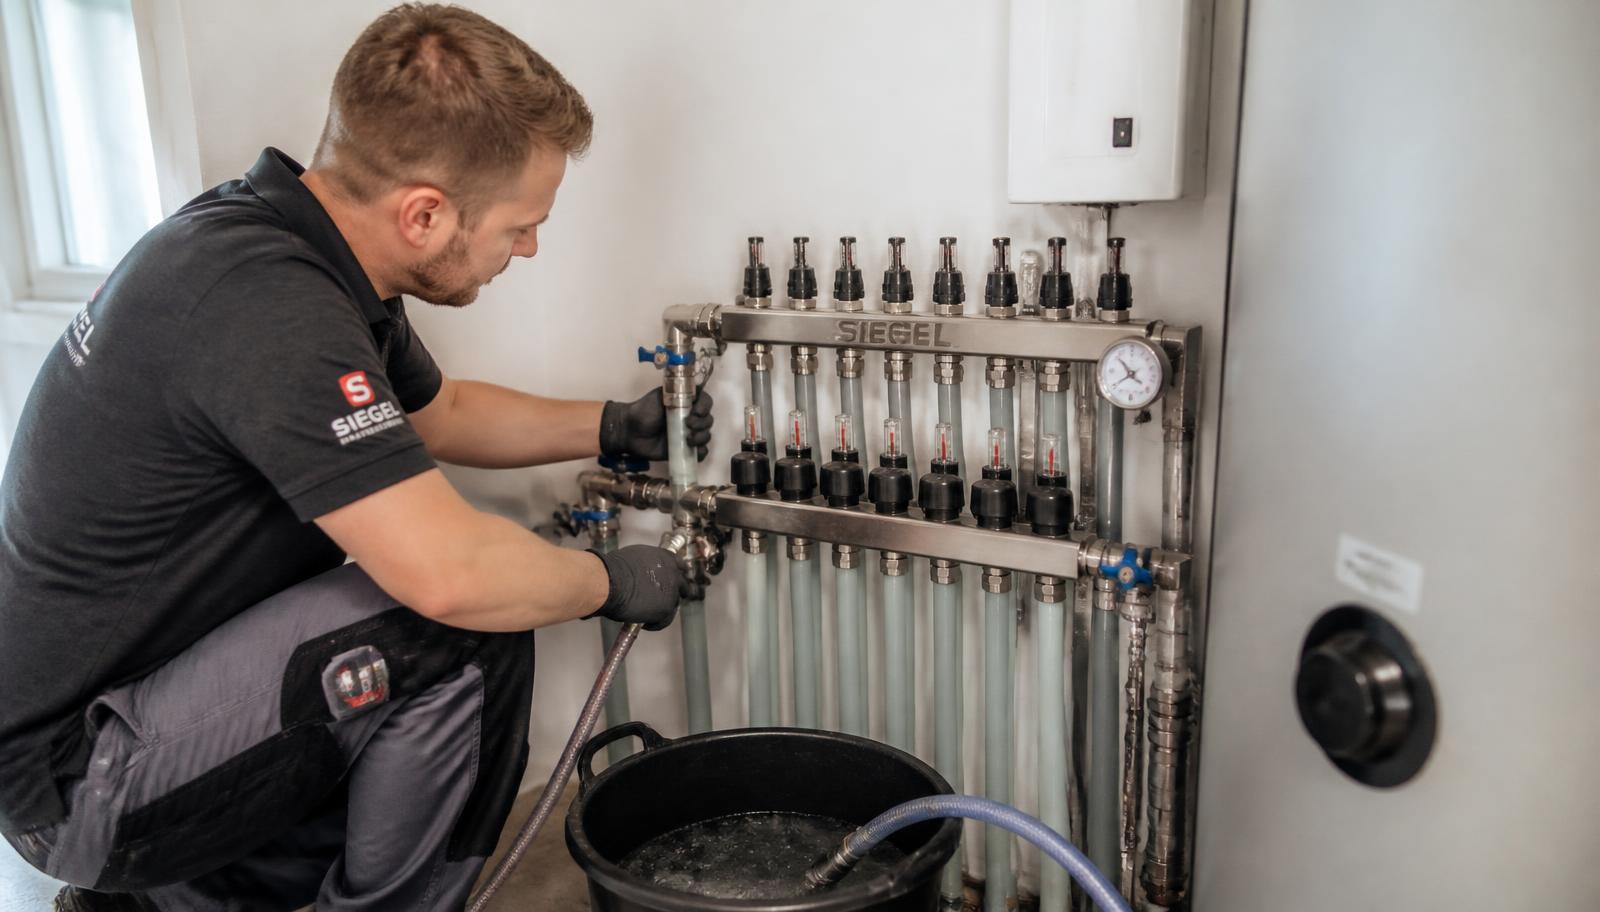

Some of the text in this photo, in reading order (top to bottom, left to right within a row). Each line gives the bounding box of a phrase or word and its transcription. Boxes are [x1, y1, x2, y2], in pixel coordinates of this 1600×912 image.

[837, 320, 952, 348] SIEGEL
[346, 375, 370, 402] S
[331, 401, 400, 437] SIEGEL
